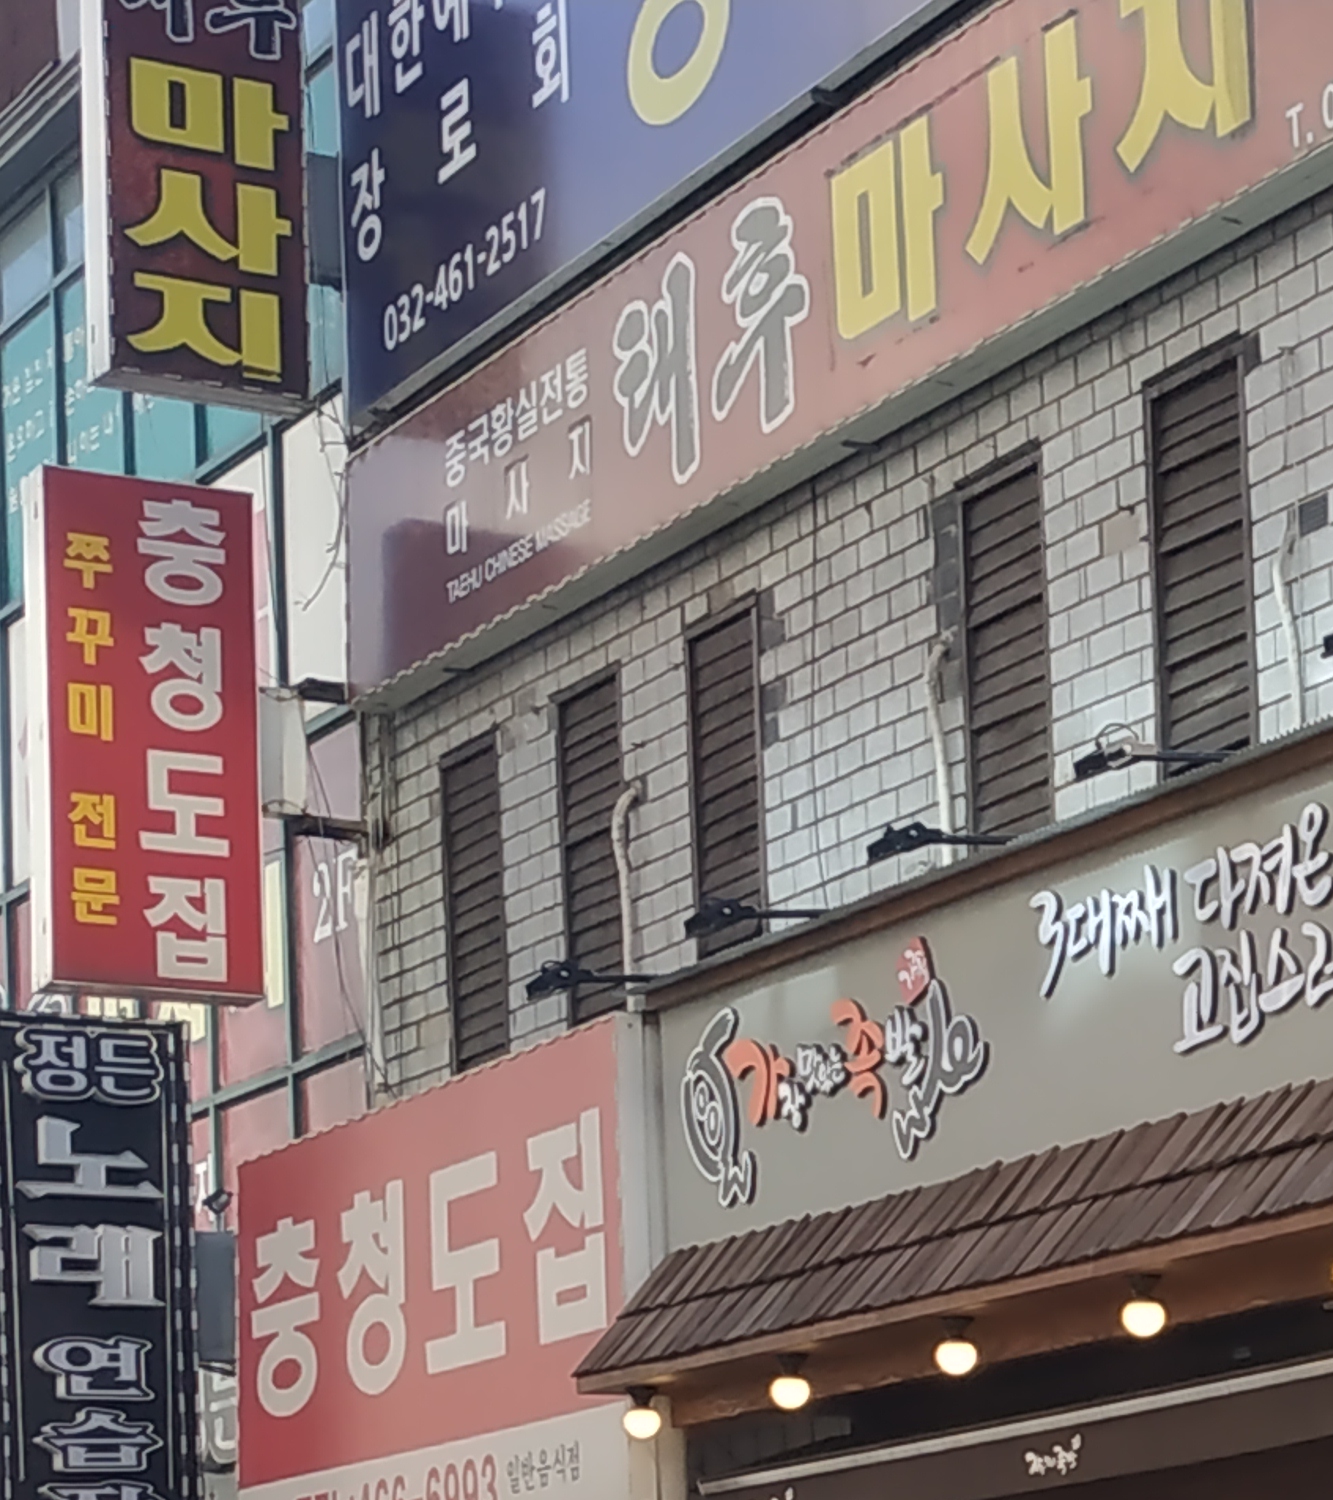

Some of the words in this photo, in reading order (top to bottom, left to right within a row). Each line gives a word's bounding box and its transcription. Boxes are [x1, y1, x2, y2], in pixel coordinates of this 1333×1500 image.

[126, 57, 291, 382] 마사지
[828, 0, 1256, 342] 마사지
[384, 188, 546, 351] 032-461-2517
[445, 347, 588, 488] 중국황실전통
[445, 417, 593, 556] 마사지
[63, 532, 114, 743] 쭈꾸미
[136, 498, 231, 984] 충청도집
[67, 791, 120, 927] 전문
[27, 1032, 156, 1097] 정든
[723, 1037, 808, 1130] 가장
[828, 998, 928, 1120] 족발
[15, 1113, 168, 1308] 노래
[250, 1106, 611, 1418] 충청도집
[504, 1440, 582, 1496] 일반음식점
